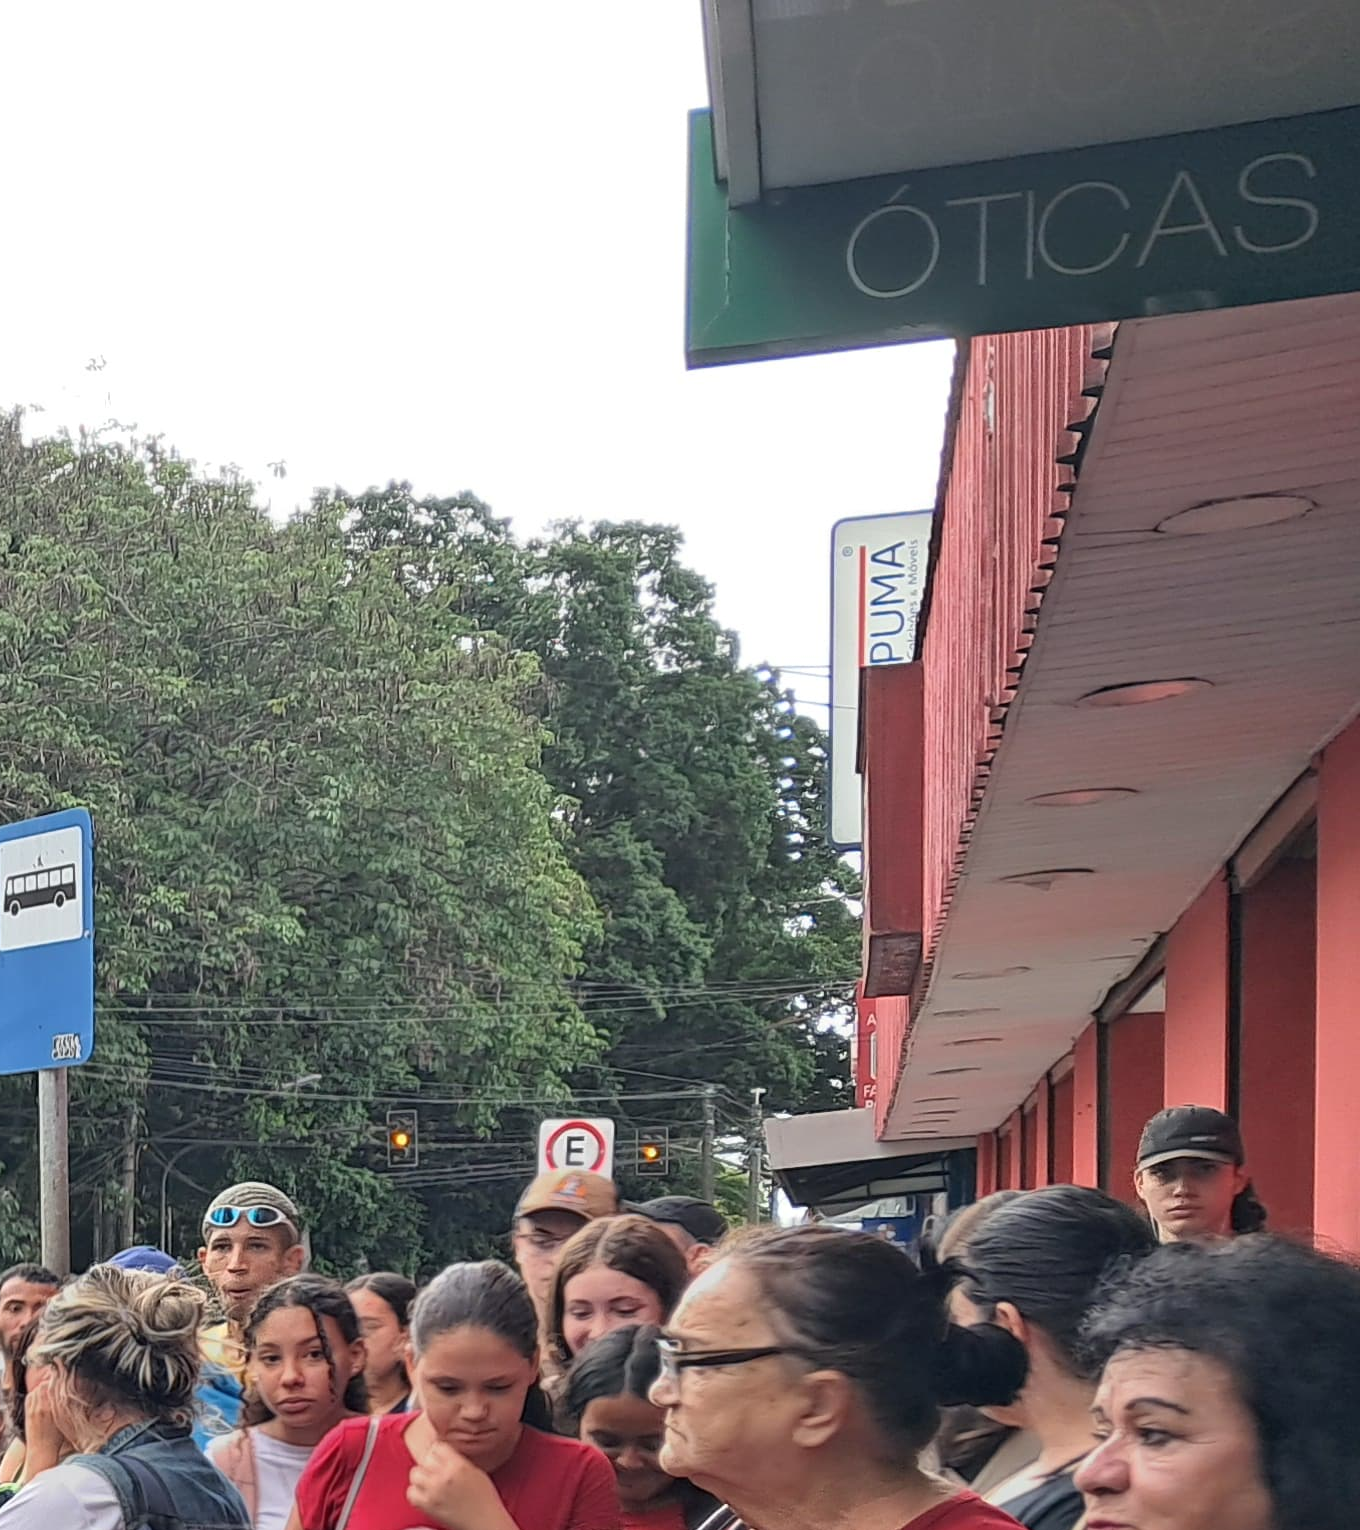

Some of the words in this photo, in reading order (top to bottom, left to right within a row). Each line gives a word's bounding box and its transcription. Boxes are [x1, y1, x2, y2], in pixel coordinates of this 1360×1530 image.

[846, 152, 1319, 298] ÓTICAS
[870, 541, 905, 663] PUMA
[565, 1135, 585, 1166] E
